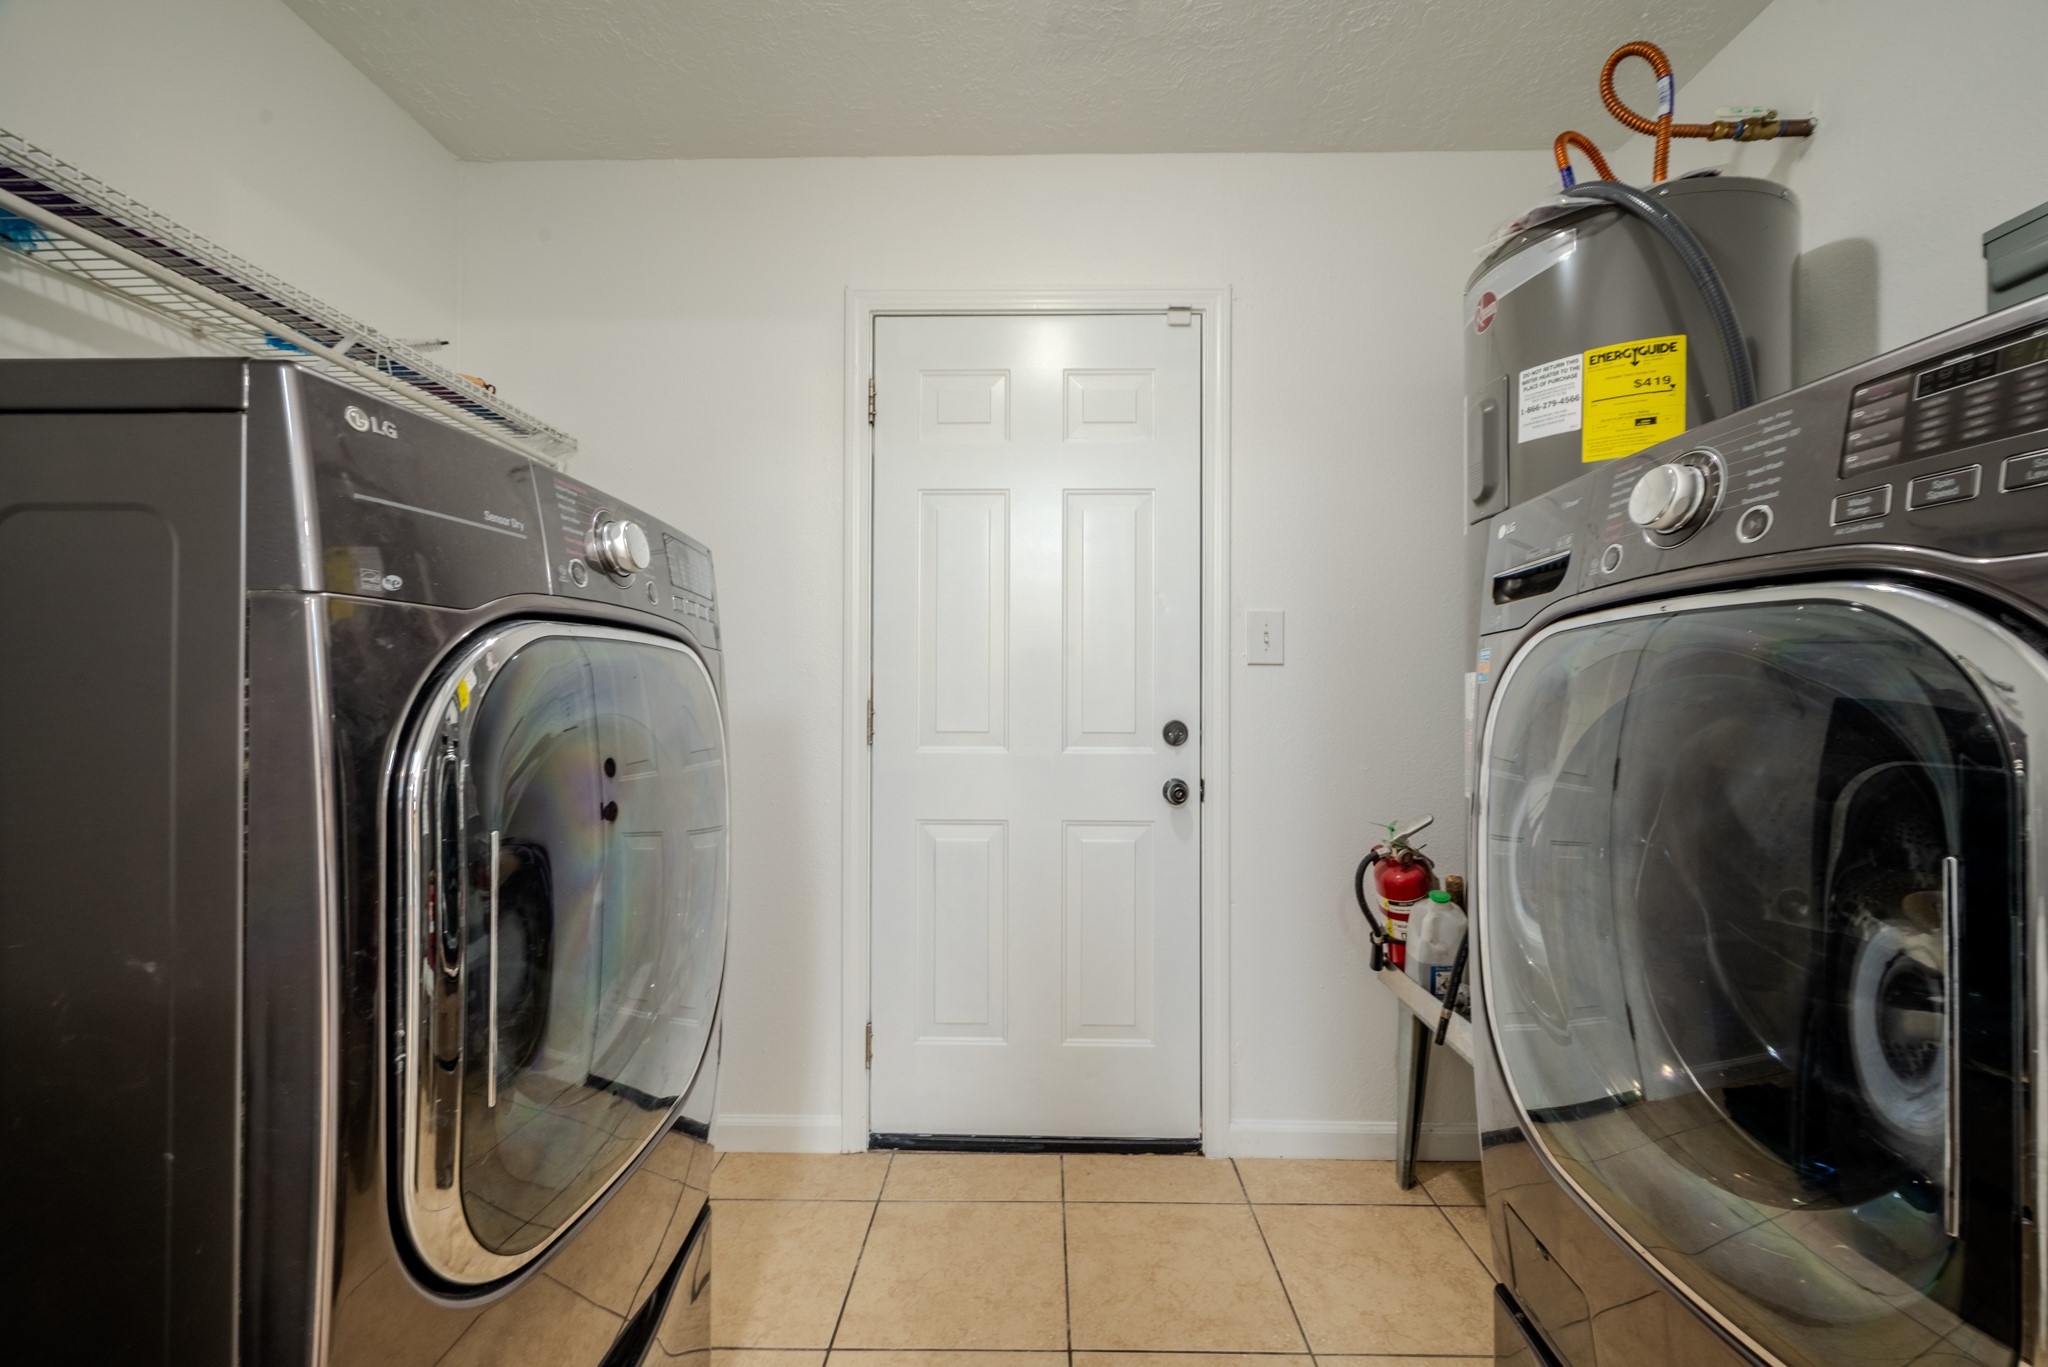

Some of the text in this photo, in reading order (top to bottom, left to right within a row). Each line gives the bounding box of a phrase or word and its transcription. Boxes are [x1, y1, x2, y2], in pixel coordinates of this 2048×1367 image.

[1590, 342, 1678, 365] ENERGYGUIDE
[1522, 377, 1538, 386] WATER
[1539, 370, 1560, 381] HEATER
[1569, 364, 1581, 372] THE
[1531, 368, 1542, 376] NOT
[1543, 361, 1565, 372] RETURN
[1566, 358, 1580, 366] THIS
[1523, 383, 1539, 392] PLACE
[1547, 372, 1578, 385] PURCHASE
[1633, 375, 1672, 389] $419
[370, 416, 398, 439] LG
[483, 510, 525, 532] Sensor Dry
